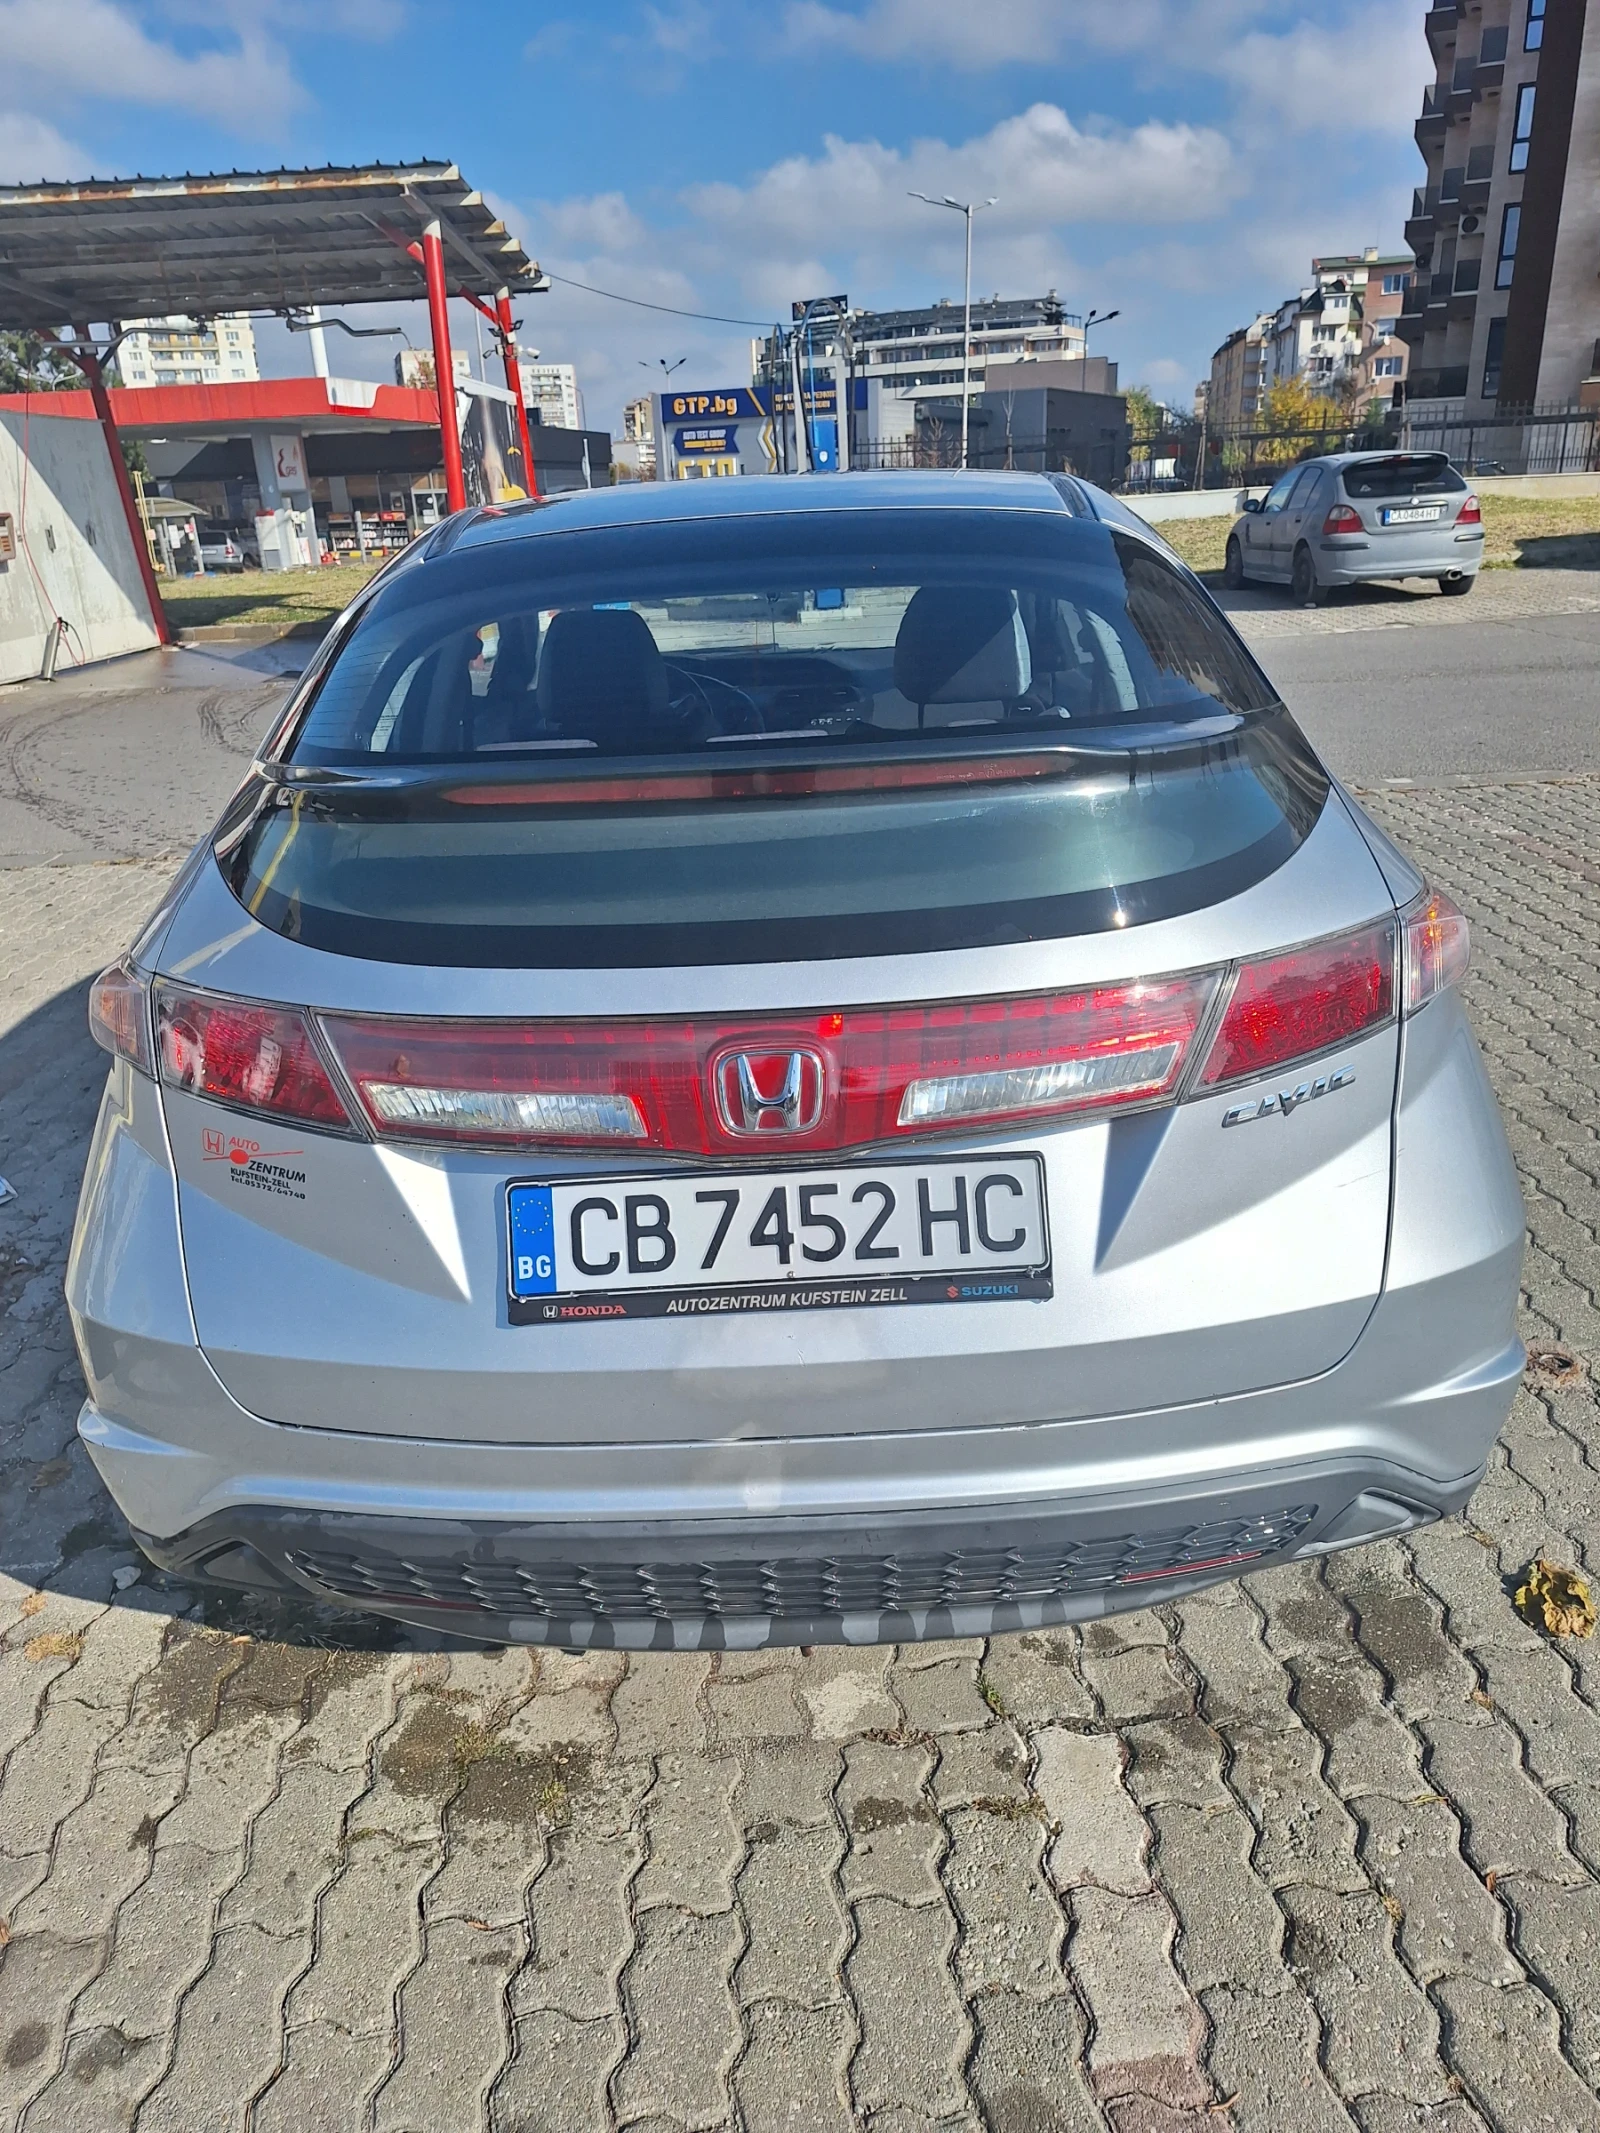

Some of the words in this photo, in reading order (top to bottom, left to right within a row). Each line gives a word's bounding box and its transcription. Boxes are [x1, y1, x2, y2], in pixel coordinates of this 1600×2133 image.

[673, 395, 738, 415] GTP.bg
[1221, 1063, 1356, 1128] CIVIC
[228, 1136, 260, 1152] AUTO
[230, 1167, 291, 1189] KUFSTEIN-ZELL
[248, 1160, 306, 1183] ZENTRUM
[570, 1194, 676, 1276] CB
[695, 1180, 900, 1270] 7452
[917, 1174, 1026, 1257] HC
[517, 1254, 551, 1280] BG
[666, 1293, 786, 1313] AUTOZENTRUM
[790, 1289, 867, 1306] KUFSTEIN
[870, 1287, 908, 1302] ZELL
[961, 1284, 1019, 1296] SUZUKI
[560, 1305, 627, 1317] HONDA
